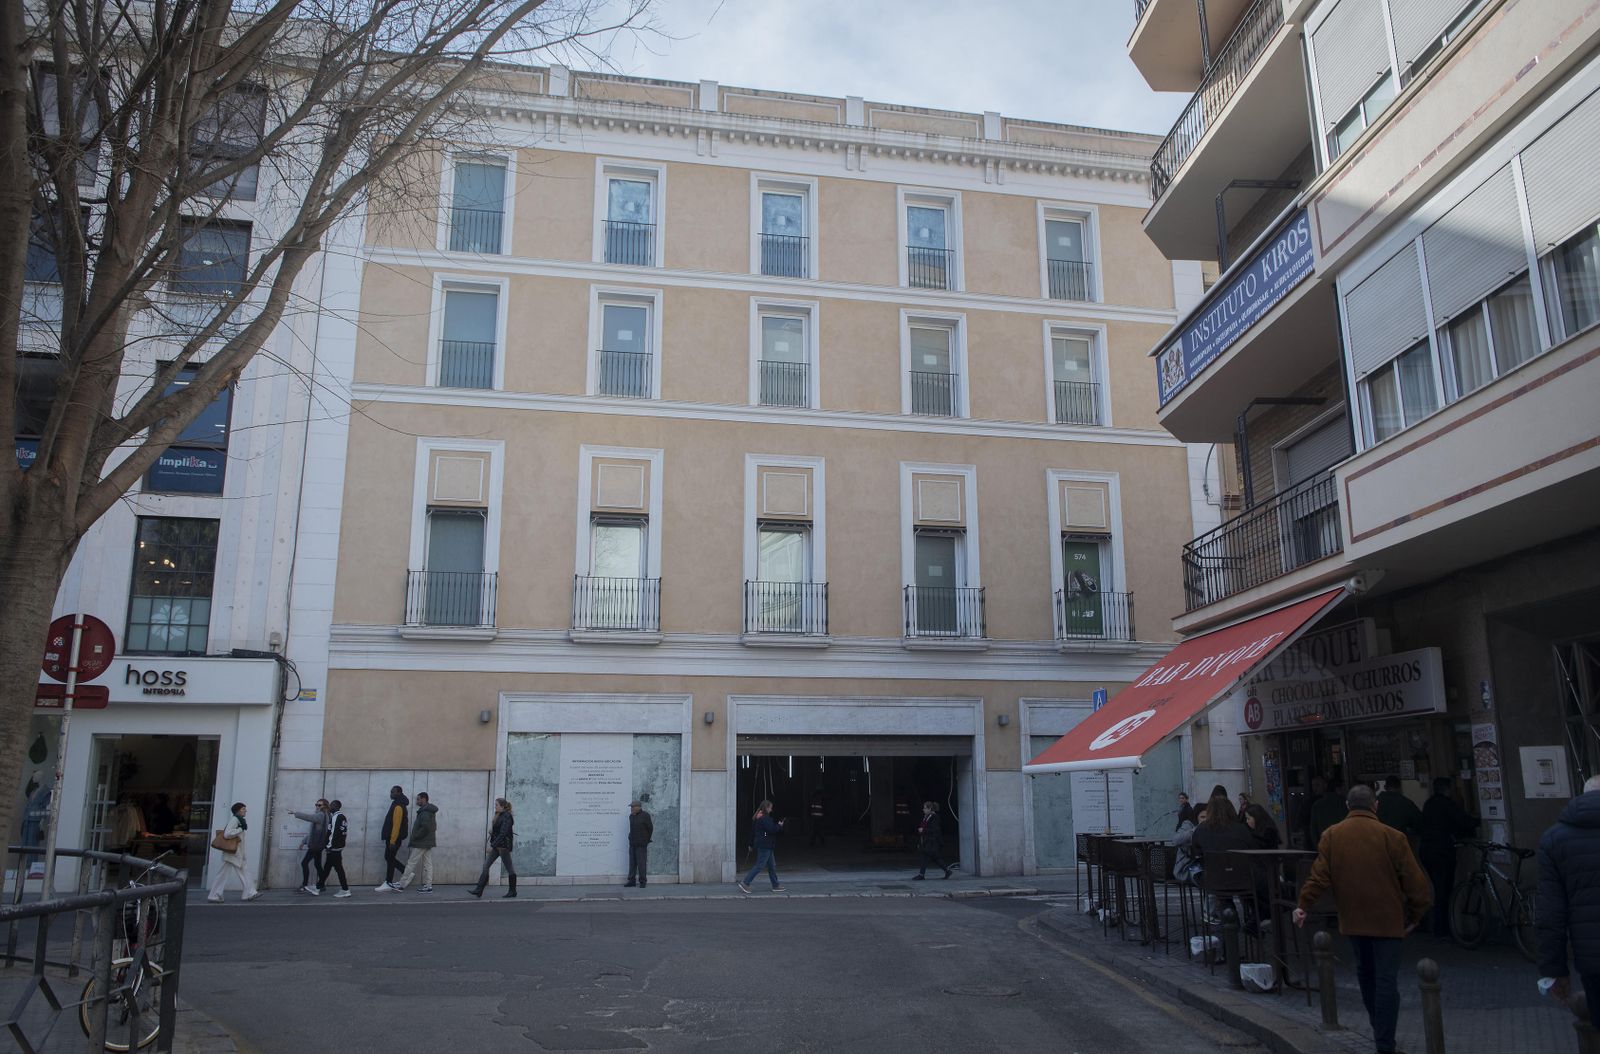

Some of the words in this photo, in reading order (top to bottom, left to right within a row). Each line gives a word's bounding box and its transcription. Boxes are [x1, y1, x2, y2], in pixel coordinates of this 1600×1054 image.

[1190, 272, 1257, 353] INSTITUTO
[1261, 217, 1309, 283] KIROS
[1274, 248, 1313, 290] AURICULOTERAPI
[159, 456, 207, 469] implika
[1134, 661, 1191, 688] BAR
[1180, 632, 1284, 681] DUQUE
[1283, 626, 1361, 677] DUQUE
[125, 663, 187, 686] hoss
[1271, 679, 1336, 706] CHOCOLATE
[1336, 674, 1349, 695] Y
[1352, 660, 1422, 691] CHURROS
[1248, 703, 1261, 723] AB
[1314, 690, 1405, 721] COMBINADOS
